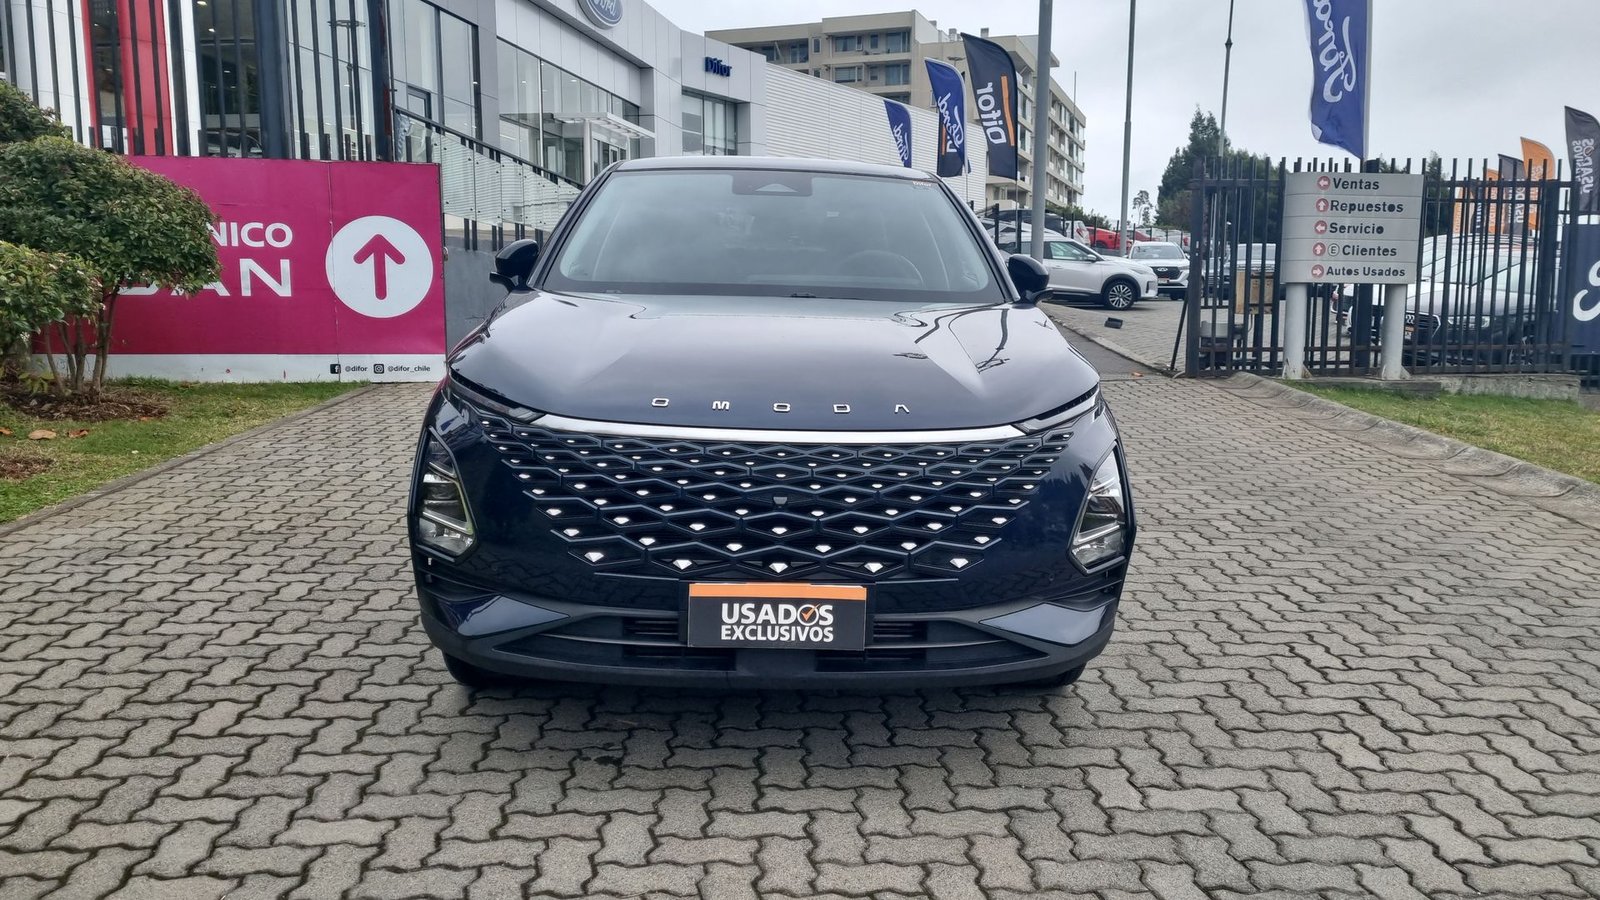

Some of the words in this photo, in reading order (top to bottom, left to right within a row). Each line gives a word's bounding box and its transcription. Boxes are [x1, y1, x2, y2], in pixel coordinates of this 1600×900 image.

[704, 56, 732, 77] Difor
[1333, 177, 1380, 190] Ventas
[1330, 199, 1404, 214] Repuestos
[205, 221, 294, 248] NICO
[1329, 222, 1384, 234] Servicio
[1342, 244, 1397, 256] Clientes
[1326, 266, 1359, 276] Autos
[1362, 266, 1406, 277] Usados
[345, 365, 368, 373] @difor
[387, 365, 431, 373] @difor_chile
[721, 603, 834, 627] USADOS
[720, 625, 834, 643] EXCLUSIVOS
